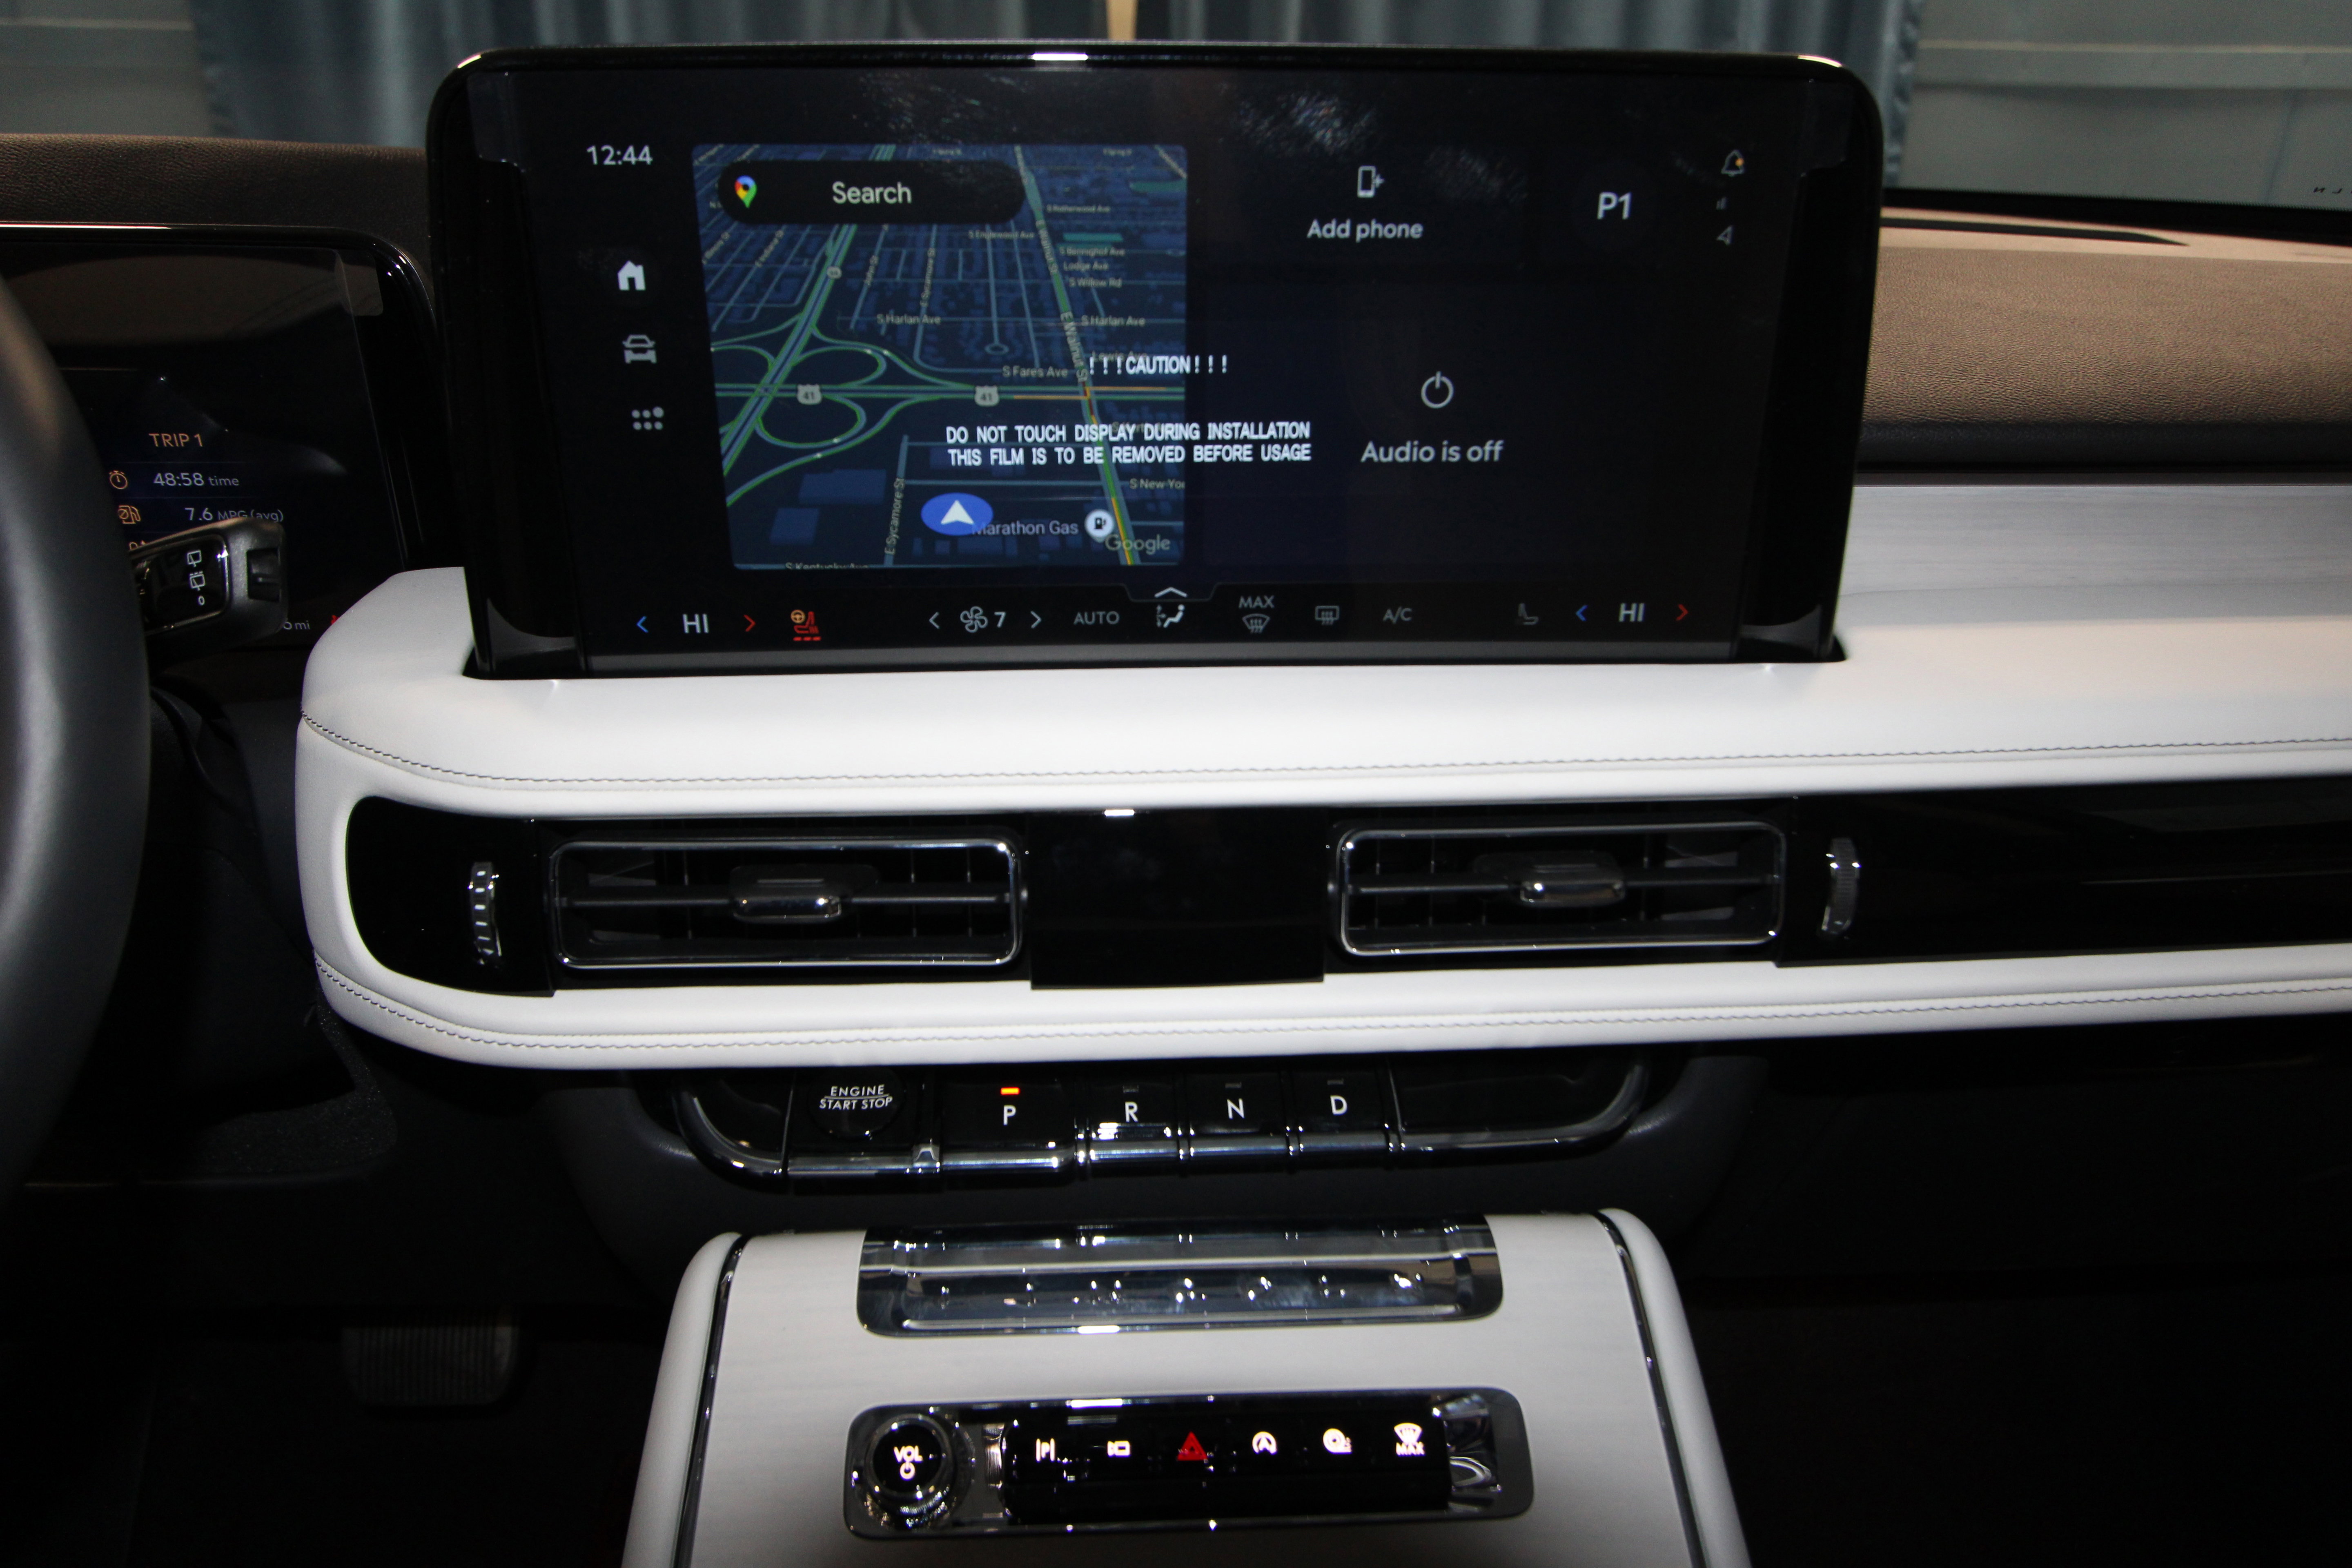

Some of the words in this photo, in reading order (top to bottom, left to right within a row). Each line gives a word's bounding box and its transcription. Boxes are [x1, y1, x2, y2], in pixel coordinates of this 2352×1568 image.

[587, 145, 653, 165] 12:44
[832, 181, 912, 204] Search
[1597, 191, 1632, 220] P1
[1307, 218, 1351, 239] Add
[1355, 218, 1424, 243] phone
[1092, 261, 1109, 271] Ave
[1069, 277, 1076, 287] S
[1077, 277, 1107, 288] Willow
[1109, 277, 1122, 288] Rd
[886, 314, 919, 325] Harlan
[922, 314, 941, 325] Ave
[1081, 314, 1089, 327] S
[1090, 314, 1125, 327] Harlan
[1126, 315, 1146, 327] Ave
[1002, 365, 1011, 378] S
[1013, 365, 1045, 378] Fares
[1046, 366, 1069, 378] Ave
[148, 433, 190, 447] TRIP
[194, 433, 203, 447] 1
[946, 426, 969, 444] DO
[976, 425, 1007, 444] NOT
[1014, 424, 1067, 443] TOUCH
[1074, 423, 1136, 442] DISPLAY
[1144, 422, 1200, 441] DURING
[1207, 421, 1311, 441] INSTALLATION
[947, 448, 982, 466] THIS
[990, 448, 1024, 466] FILM
[1031, 447, 1047, 466] IS
[1054, 446, 1076, 465] TO
[1083, 446, 1104, 464] BE
[1112, 445, 1186, 464] REMOVED
[1193, 444, 1254, 463] BEFORE
[1261, 443, 1312, 462] USAGE
[1361, 440, 1436, 463] Audio
[1441, 440, 1461, 462] is
[1466, 439, 1504, 462] off
[153, 472, 205, 486] 48:58
[207, 475, 239, 486] time
[893, 478, 905, 490] St
[1129, 478, 1138, 490] S
[1140, 478, 1165, 489] New
[185, 508, 213, 521] 7.6
[218, 510, 247, 520] MPG
[251, 509, 283, 522] (avg)
[886, 491, 904, 546] Sycamore
[1049, 520, 1079, 535] Gas
[884, 547, 895, 555] E
[1105, 534, 1171, 556] Google
[1238, 595, 1275, 609] MAX
[994, 611, 1006, 628] 7
[1073, 610, 1120, 626] AUTO
[1383, 606, 1412, 624] A/C
[1618, 603, 1645, 622] HI
[294, 620, 310, 630] mi
[682, 613, 709, 634] HI
[830, 1084, 885, 1097] ENGINE
[819, 1098, 856, 1110] START
[861, 1096, 893, 1110] STOP
[1227, 1098, 1245, 1120] N
[1330, 1095, 1348, 1116] D
[1003, 1105, 1017, 1126] P
[1125, 1101, 1138, 1123] R
[893, 1445, 924, 1462] VOL
[1396, 1441, 1425, 1457] MAX
